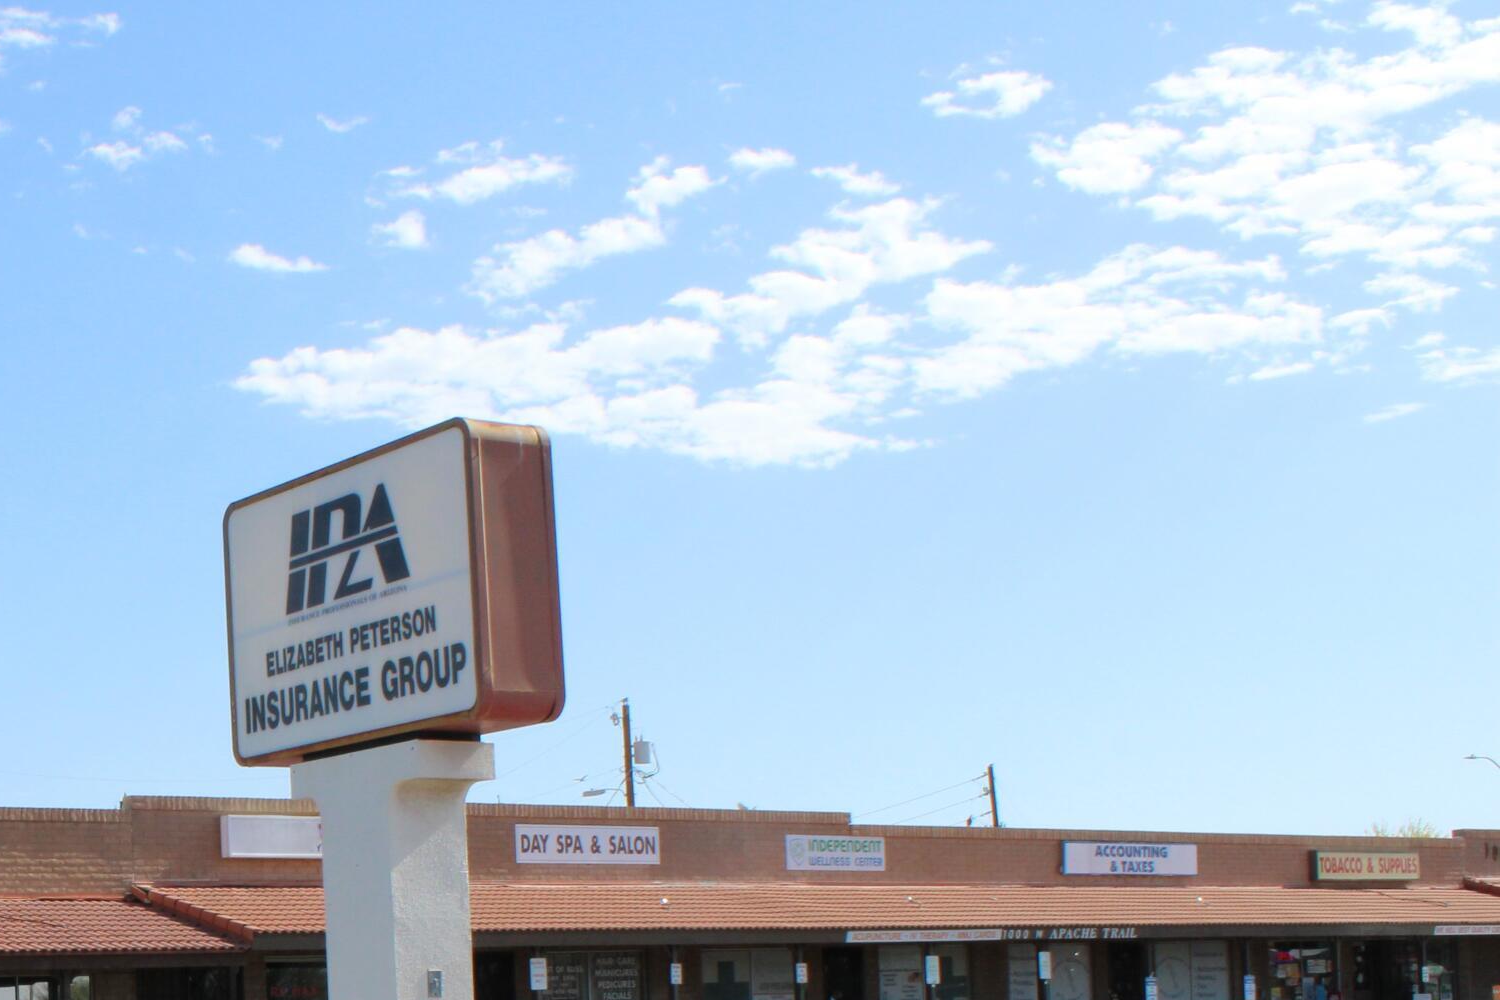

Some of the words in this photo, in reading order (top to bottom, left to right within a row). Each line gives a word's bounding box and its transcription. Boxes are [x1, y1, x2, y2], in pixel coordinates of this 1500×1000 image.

[266, 632, 344, 677] ELIZABETH
[350, 605, 437, 653] PETERSON
[245, 667, 372, 735] INSURANCE
[381, 643, 467, 702] GROUP
[520, 834, 548, 853] DAY
[556, 834, 583, 854] SPA
[590, 835, 601, 854] &
[609, 835, 656, 855] SALON
[808, 839, 882, 853] INDEPENDENT
[1095, 845, 1168, 858] ACCOUNTING
[809, 856, 851, 866] WELLNESS
[855, 857, 882, 866] CENTER
[1110, 861, 1117, 872] &
[1121, 861, 1155, 872] TAXES
[1319, 857, 1363, 873] TOBACCO
[1367, 857, 1374, 873] &
[1378, 857, 1417, 873] SUPPLIES
[1049, 928, 1098, 939] APACHE
[1102, 928, 1138, 939] TRAIL
